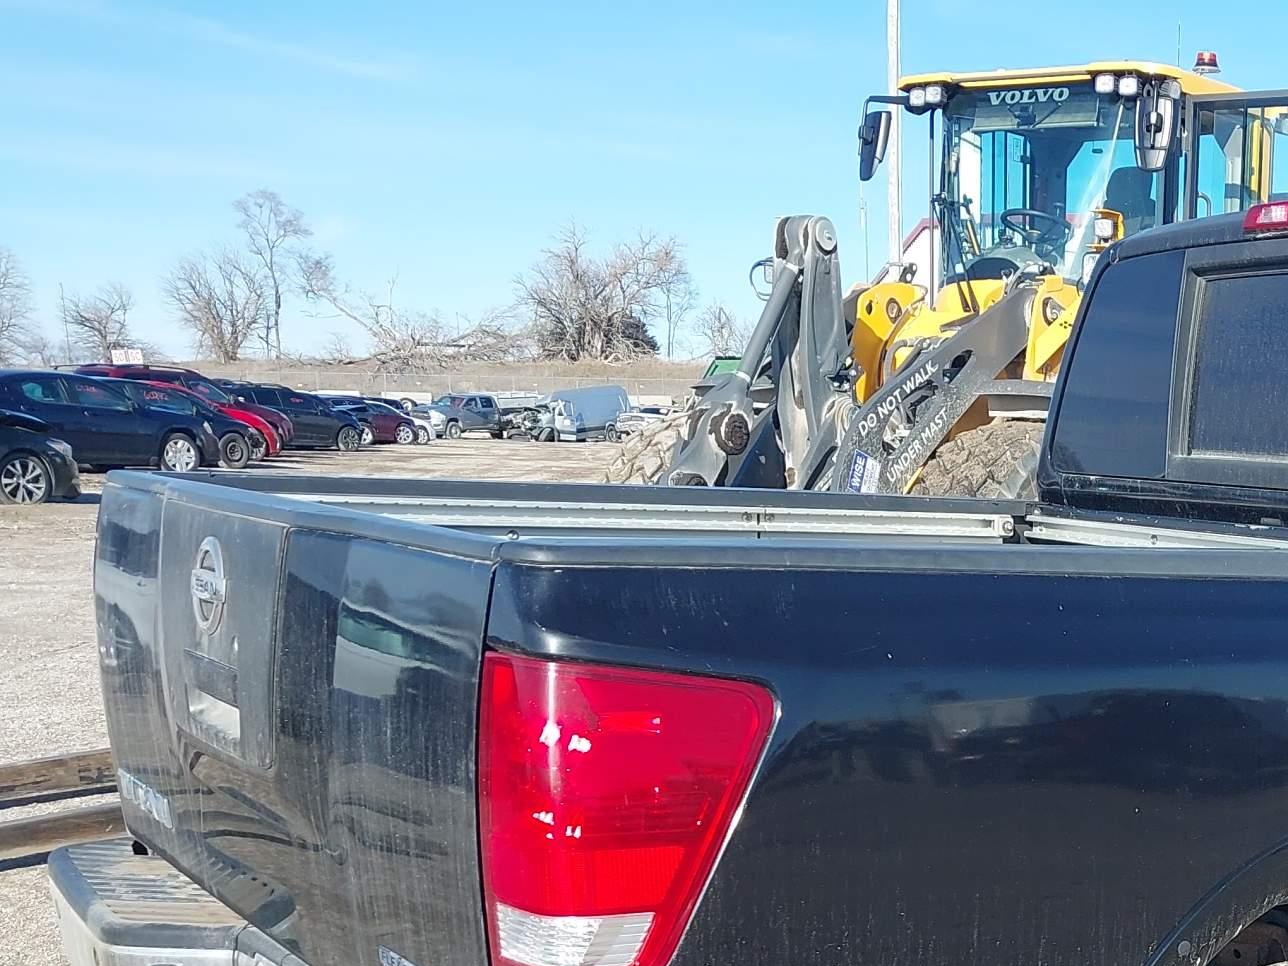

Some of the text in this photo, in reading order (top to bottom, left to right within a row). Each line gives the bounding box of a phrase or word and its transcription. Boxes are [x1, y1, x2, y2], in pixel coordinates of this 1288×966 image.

[987, 87, 1070, 106] VOLVO
[858, 360, 939, 437] DO NOT WALK
[886, 406, 948, 481] UNDER MAST
[851, 455, 866, 487] WISE
